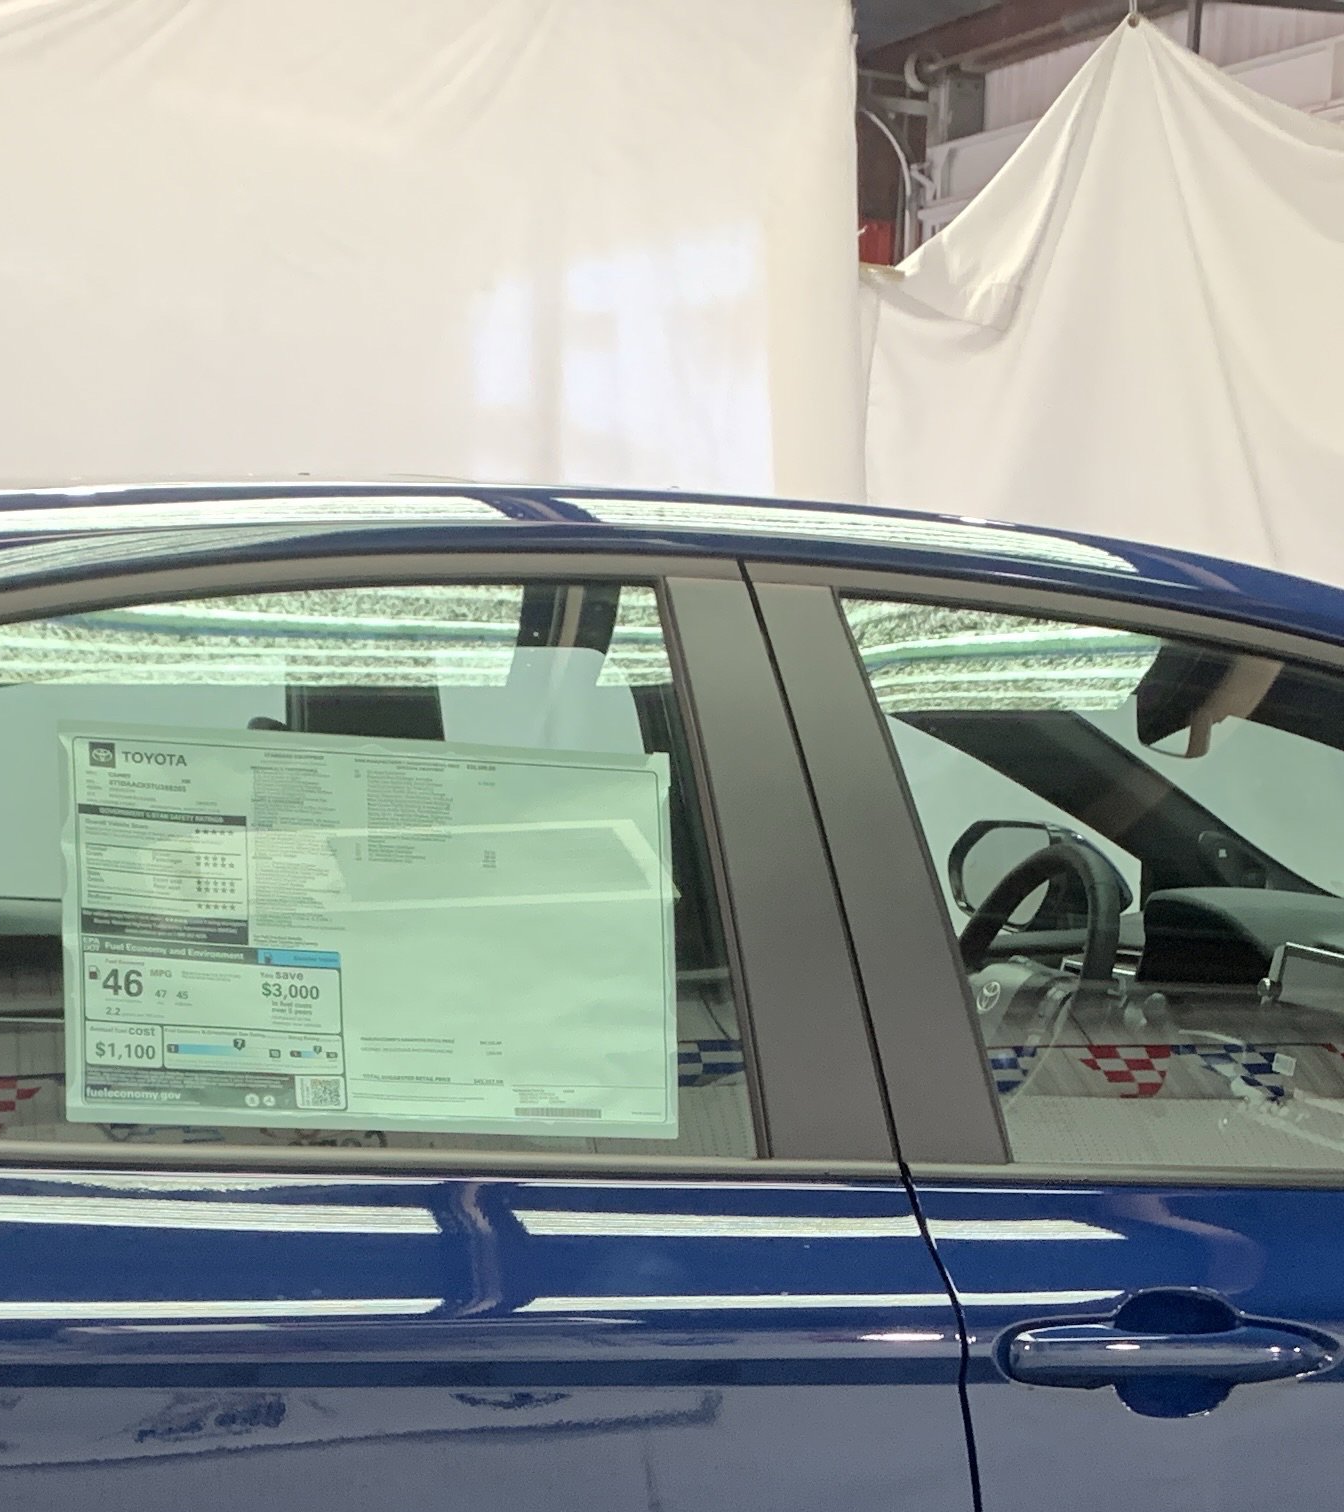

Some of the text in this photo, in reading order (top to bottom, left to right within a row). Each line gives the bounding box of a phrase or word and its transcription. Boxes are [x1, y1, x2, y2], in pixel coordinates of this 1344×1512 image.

[121, 750, 188, 767] TOYOTA
[83, 936, 100, 945] EPA
[104, 941, 245, 960] Fuel Economy and Environment
[149, 968, 173, 978] MPG
[275, 971, 304, 981] save
[102, 967, 144, 998] 46
[154, 989, 167, 999] 47
[176, 990, 189, 1000] 45
[261, 981, 320, 1001] $3,000
[128, 1026, 156, 1037] cost
[94, 1041, 156, 1061] $1,100
[85, 1086, 182, 1100] fueleconomy.gov
